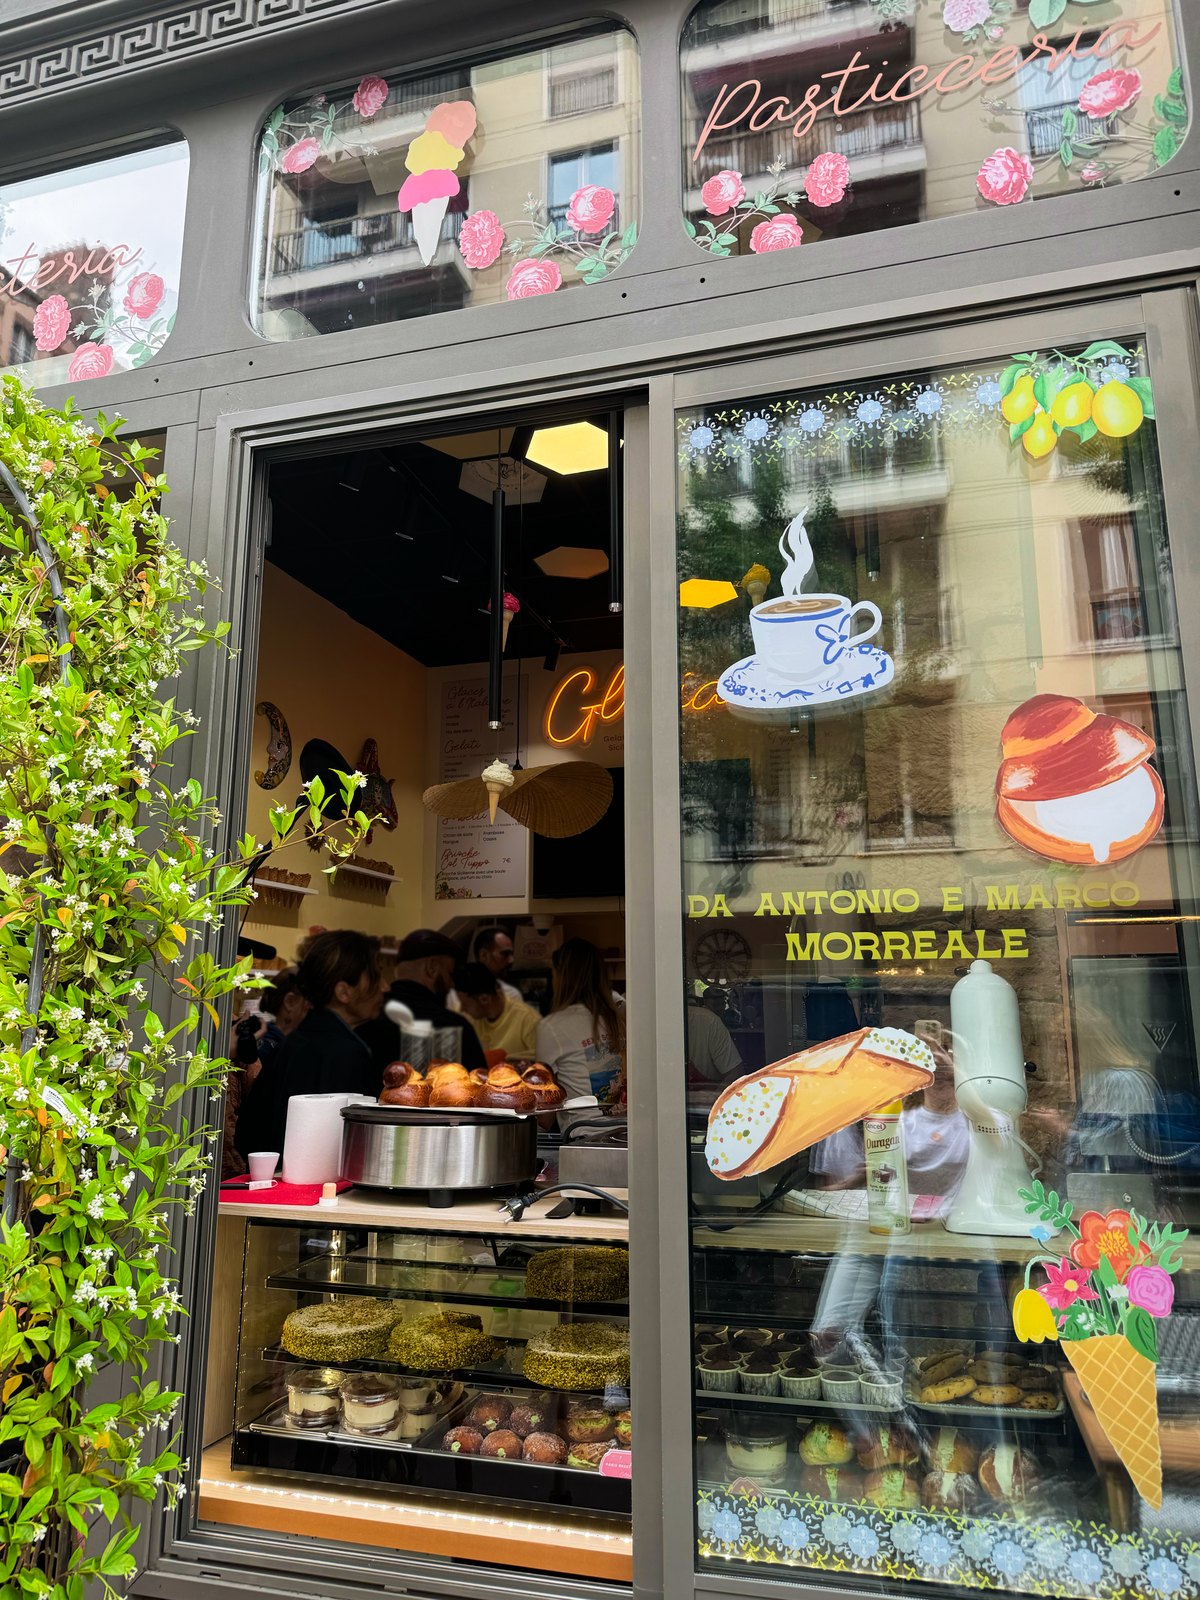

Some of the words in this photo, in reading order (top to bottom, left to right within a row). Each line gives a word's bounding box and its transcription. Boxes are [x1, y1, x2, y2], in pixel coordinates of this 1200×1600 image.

[693, 19, 1162, 162] Pasticceria
[0, 241, 143, 297] teria
[444, 738, 481, 754] Gelati
[688, 893, 734, 918] DA
[753, 887, 920, 917] ANTONIO
[941, 886, 965, 912] E
[985, 880, 1141, 911] MARCO
[785, 928, 1029, 961] MORREALE
[866, 1135, 900, 1150] Ouragan
